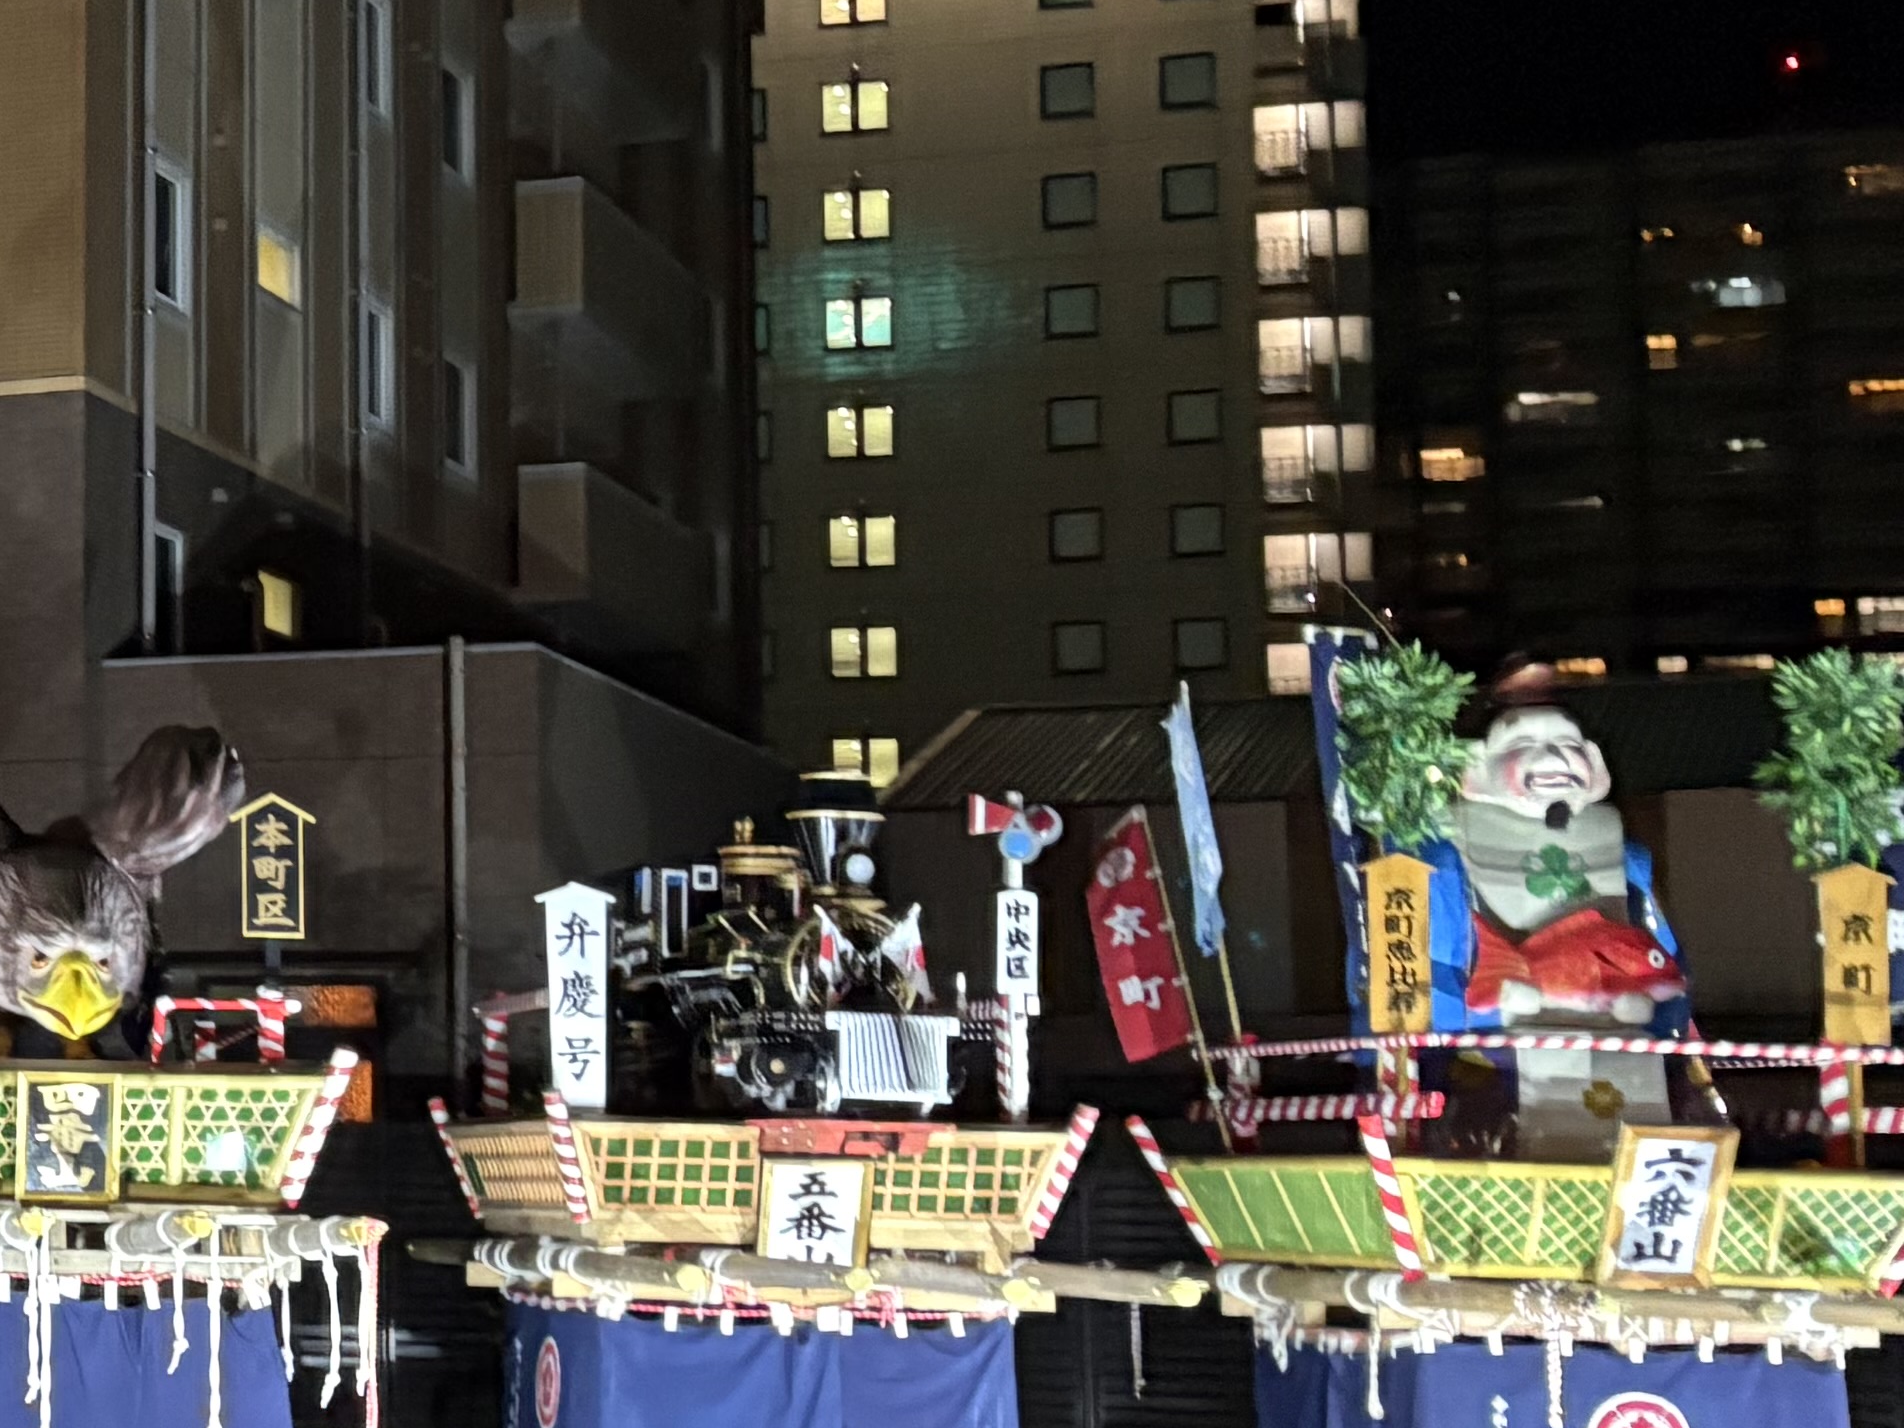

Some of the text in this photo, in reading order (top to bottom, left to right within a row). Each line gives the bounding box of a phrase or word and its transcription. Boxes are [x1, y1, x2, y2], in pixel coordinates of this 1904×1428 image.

[250, 813, 296, 927] 本町区
[1005, 899, 1032, 979] 中央区
[1103, 904, 1164, 1011] 京町
[1841, 913, 1875, 996] 京町
[555, 911, 604, 1082] 弁慶号
[34, 1082, 101, 1189] 四番山
[1622, 1147, 1707, 1263] 六番山
